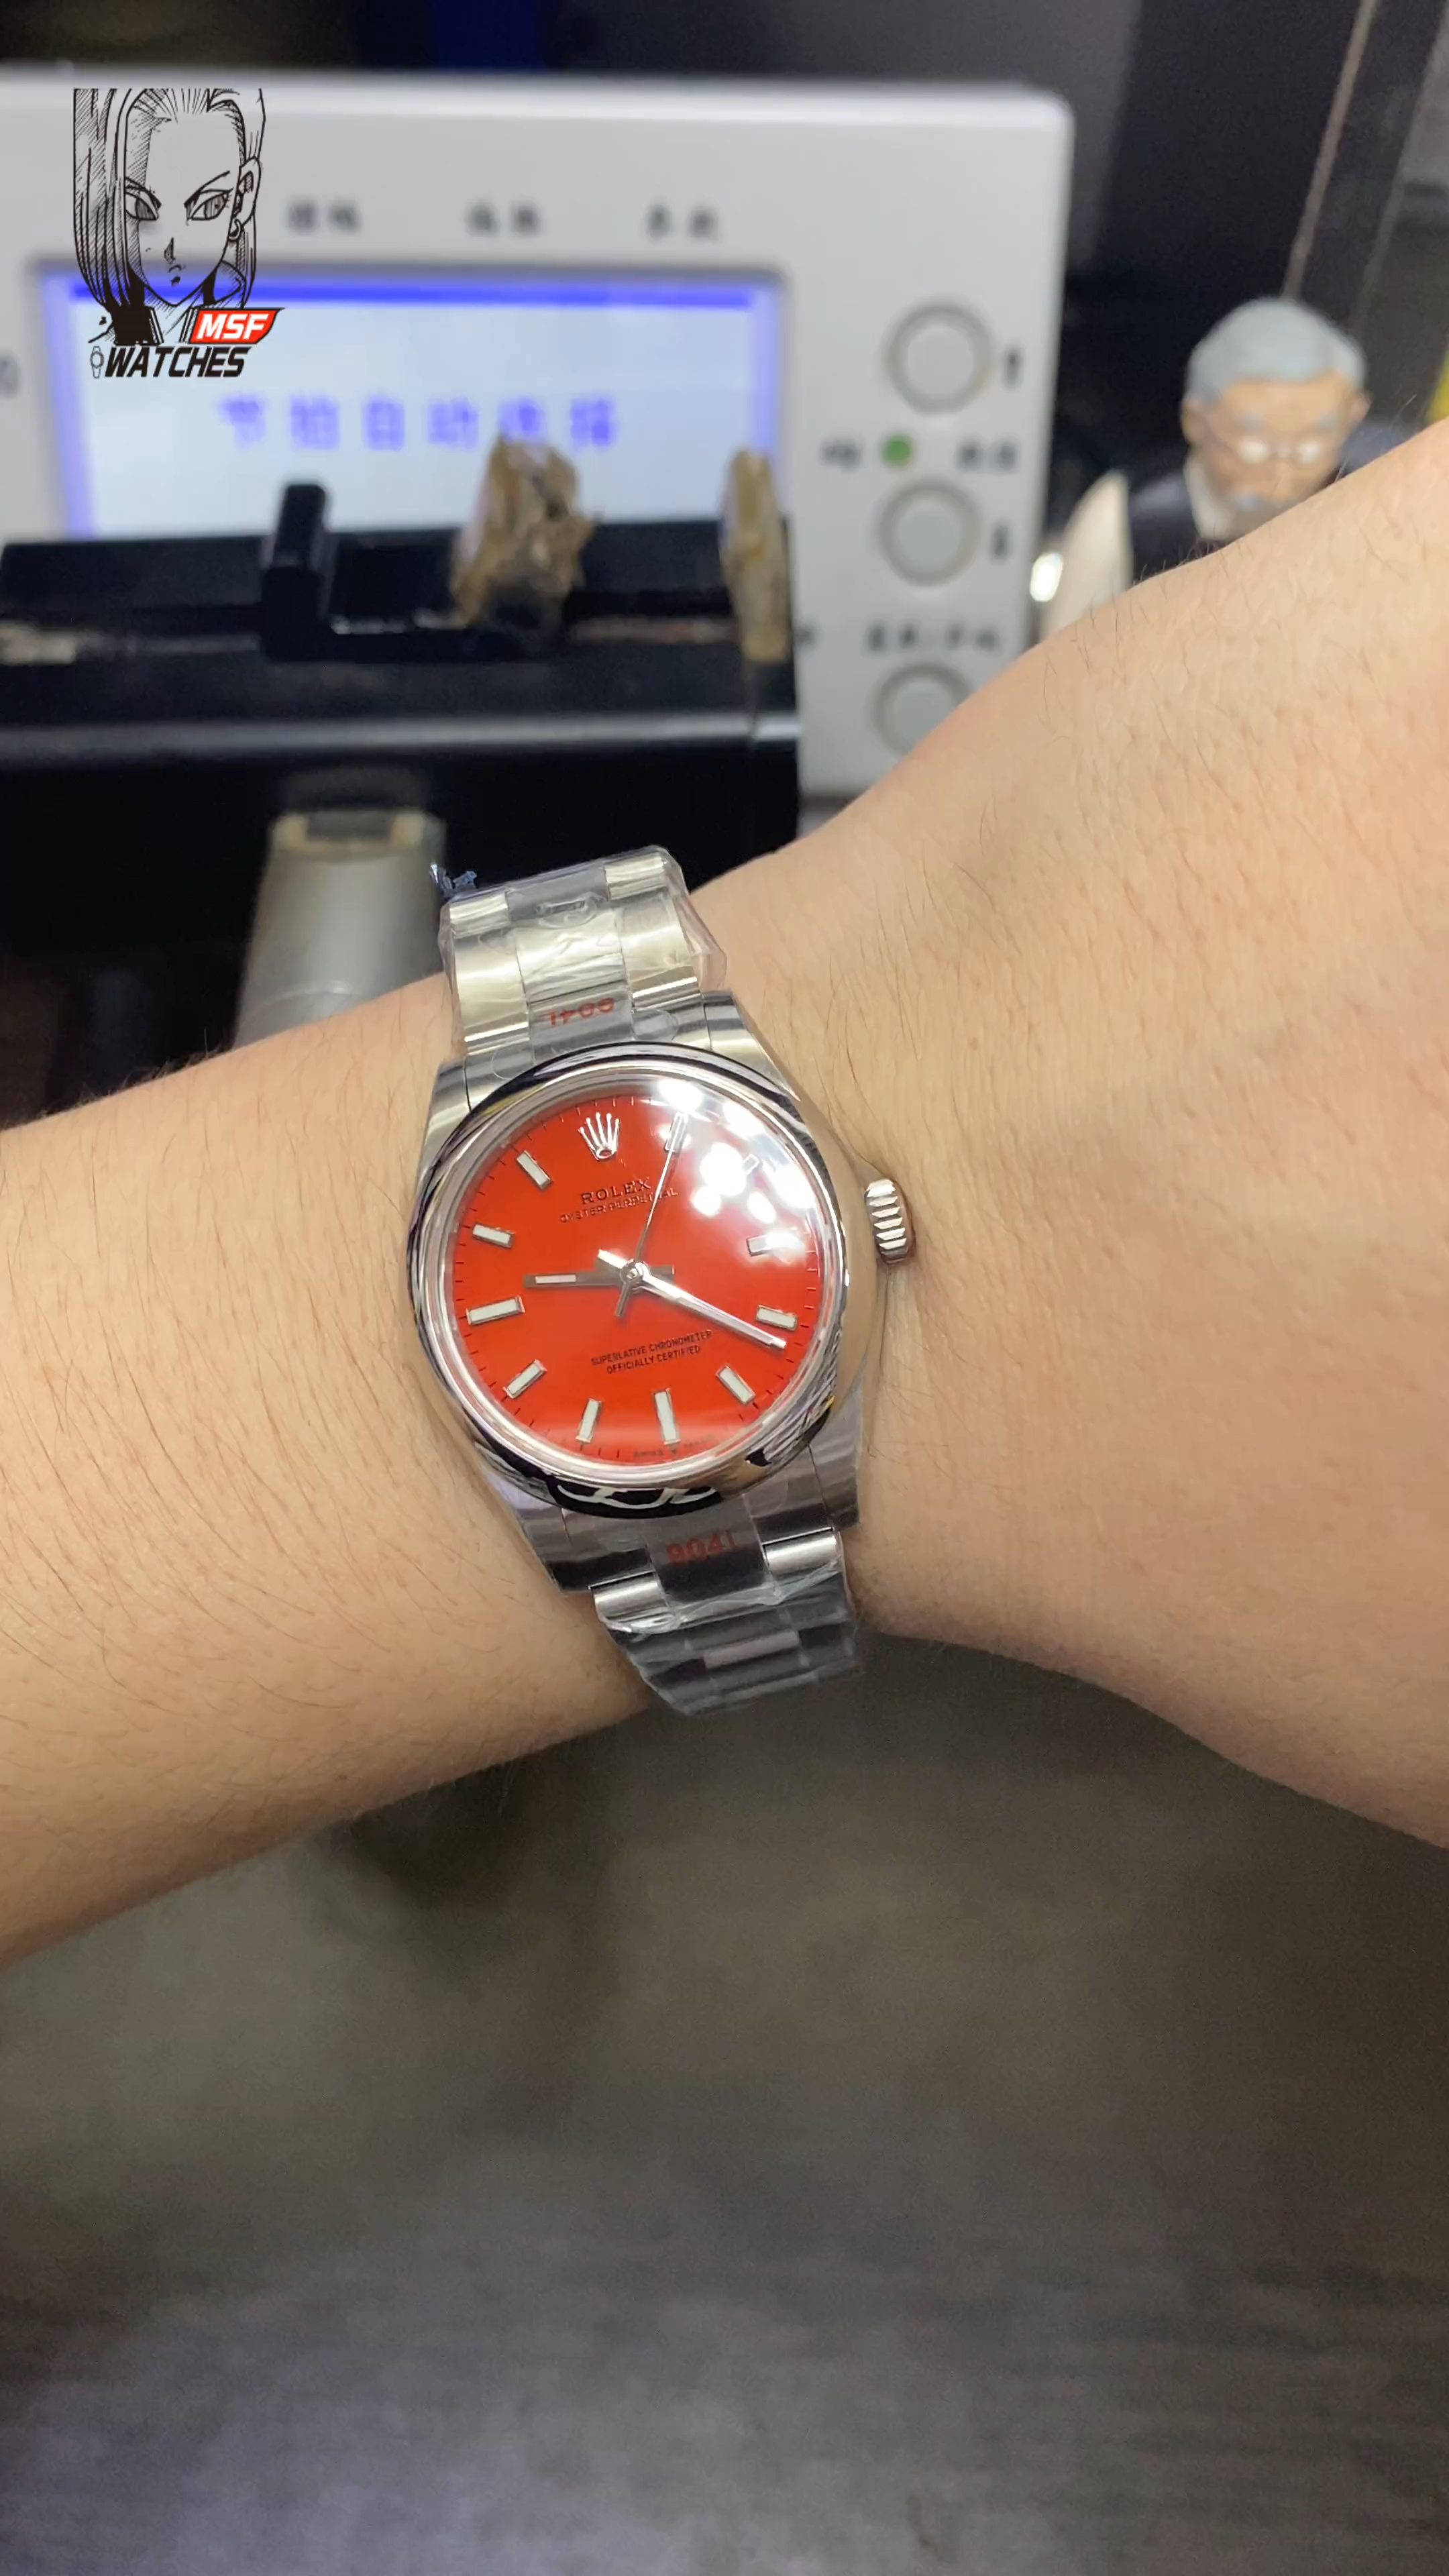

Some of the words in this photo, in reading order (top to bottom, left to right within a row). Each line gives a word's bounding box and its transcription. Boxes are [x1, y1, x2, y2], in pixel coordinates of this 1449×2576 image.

[580, 1177, 651, 1205] ROLEX
[560, 1205, 606, 1224] OYSTER
[591, 1346, 647, 1366] SUPERLATIVE
[649, 1330, 712, 1352] CHRONOMETER
[606, 1356, 655, 1374] OFFICIALLY
[656, 1345, 701, 1362] CERTIFIED
